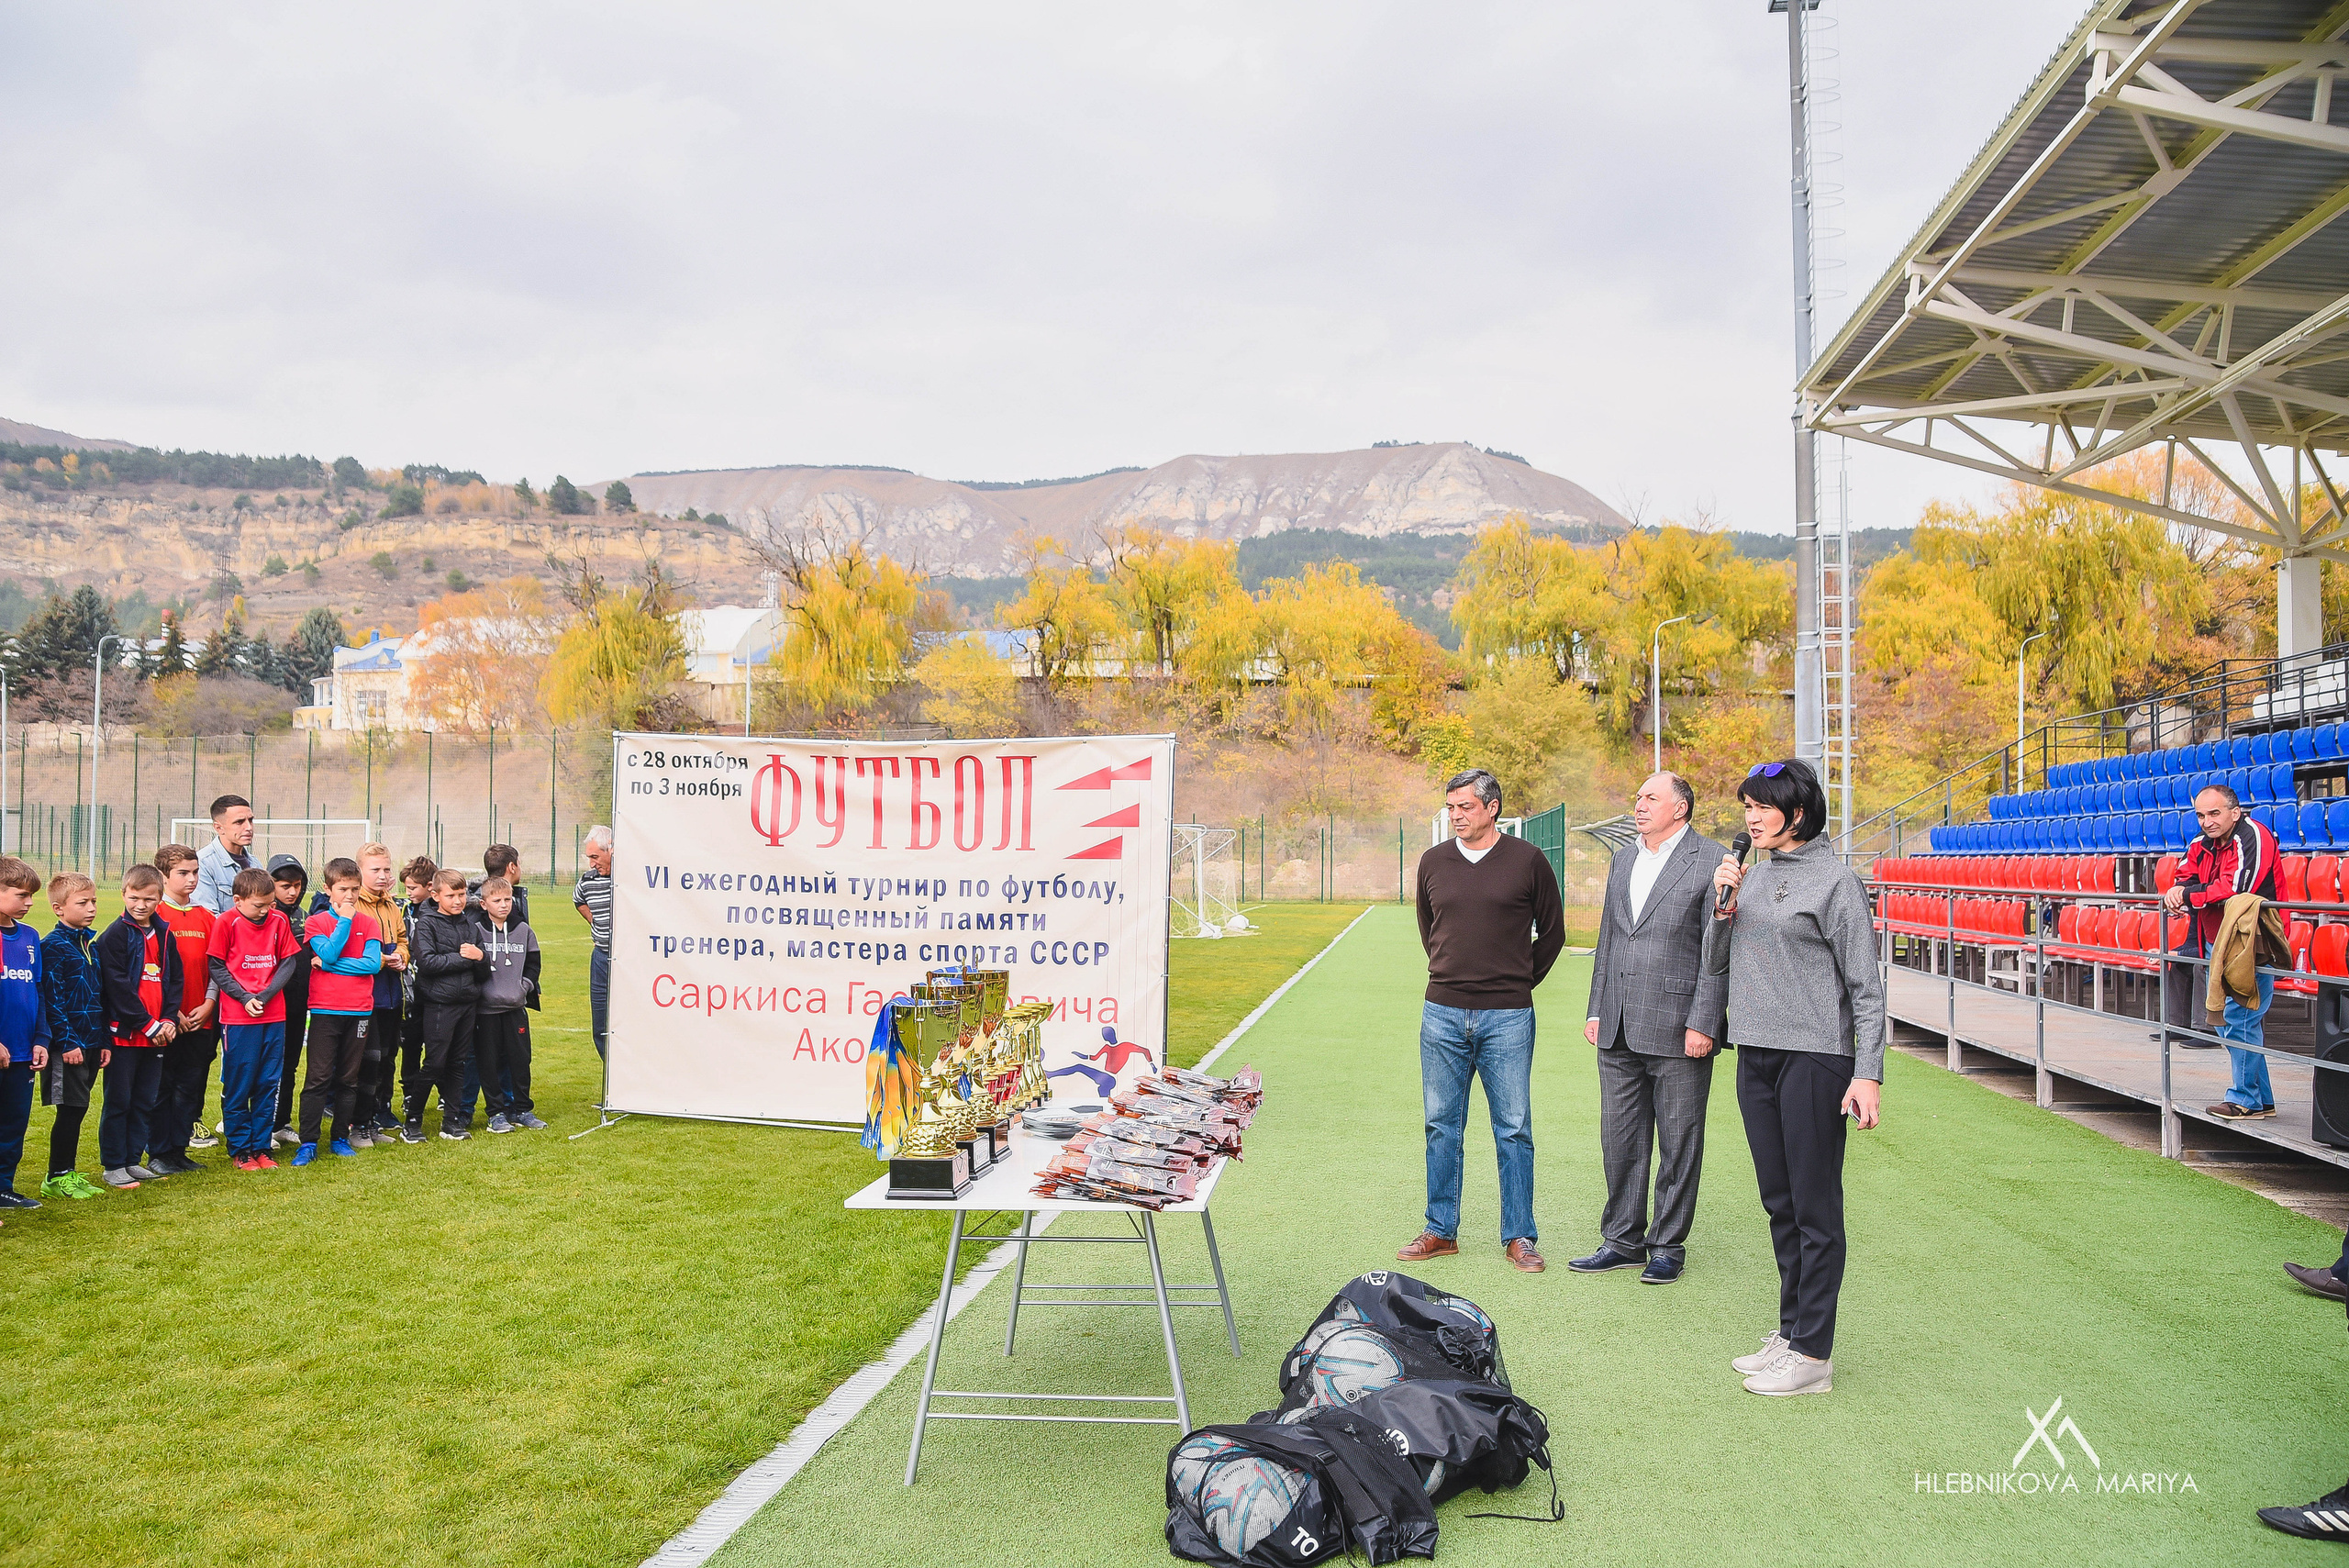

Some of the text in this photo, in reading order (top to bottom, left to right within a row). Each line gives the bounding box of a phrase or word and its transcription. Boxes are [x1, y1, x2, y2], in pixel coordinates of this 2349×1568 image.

[627, 751, 749, 773] с 28 октября
[630, 778, 742, 800] по 3 ноября
[750, 753, 1038, 852] ФУТБОЛ
[645, 865, 1125, 905] VI ежегодный турнир по футболу,
[727, 905, 1046, 931] посвященный памяти
[649, 934, 1109, 969] тренера, мастера спорта СССР
[0, 965, 33, 984] Jeep
[241, 962, 273, 970] Chartered
[651, 973, 826, 1017] Саркиса
